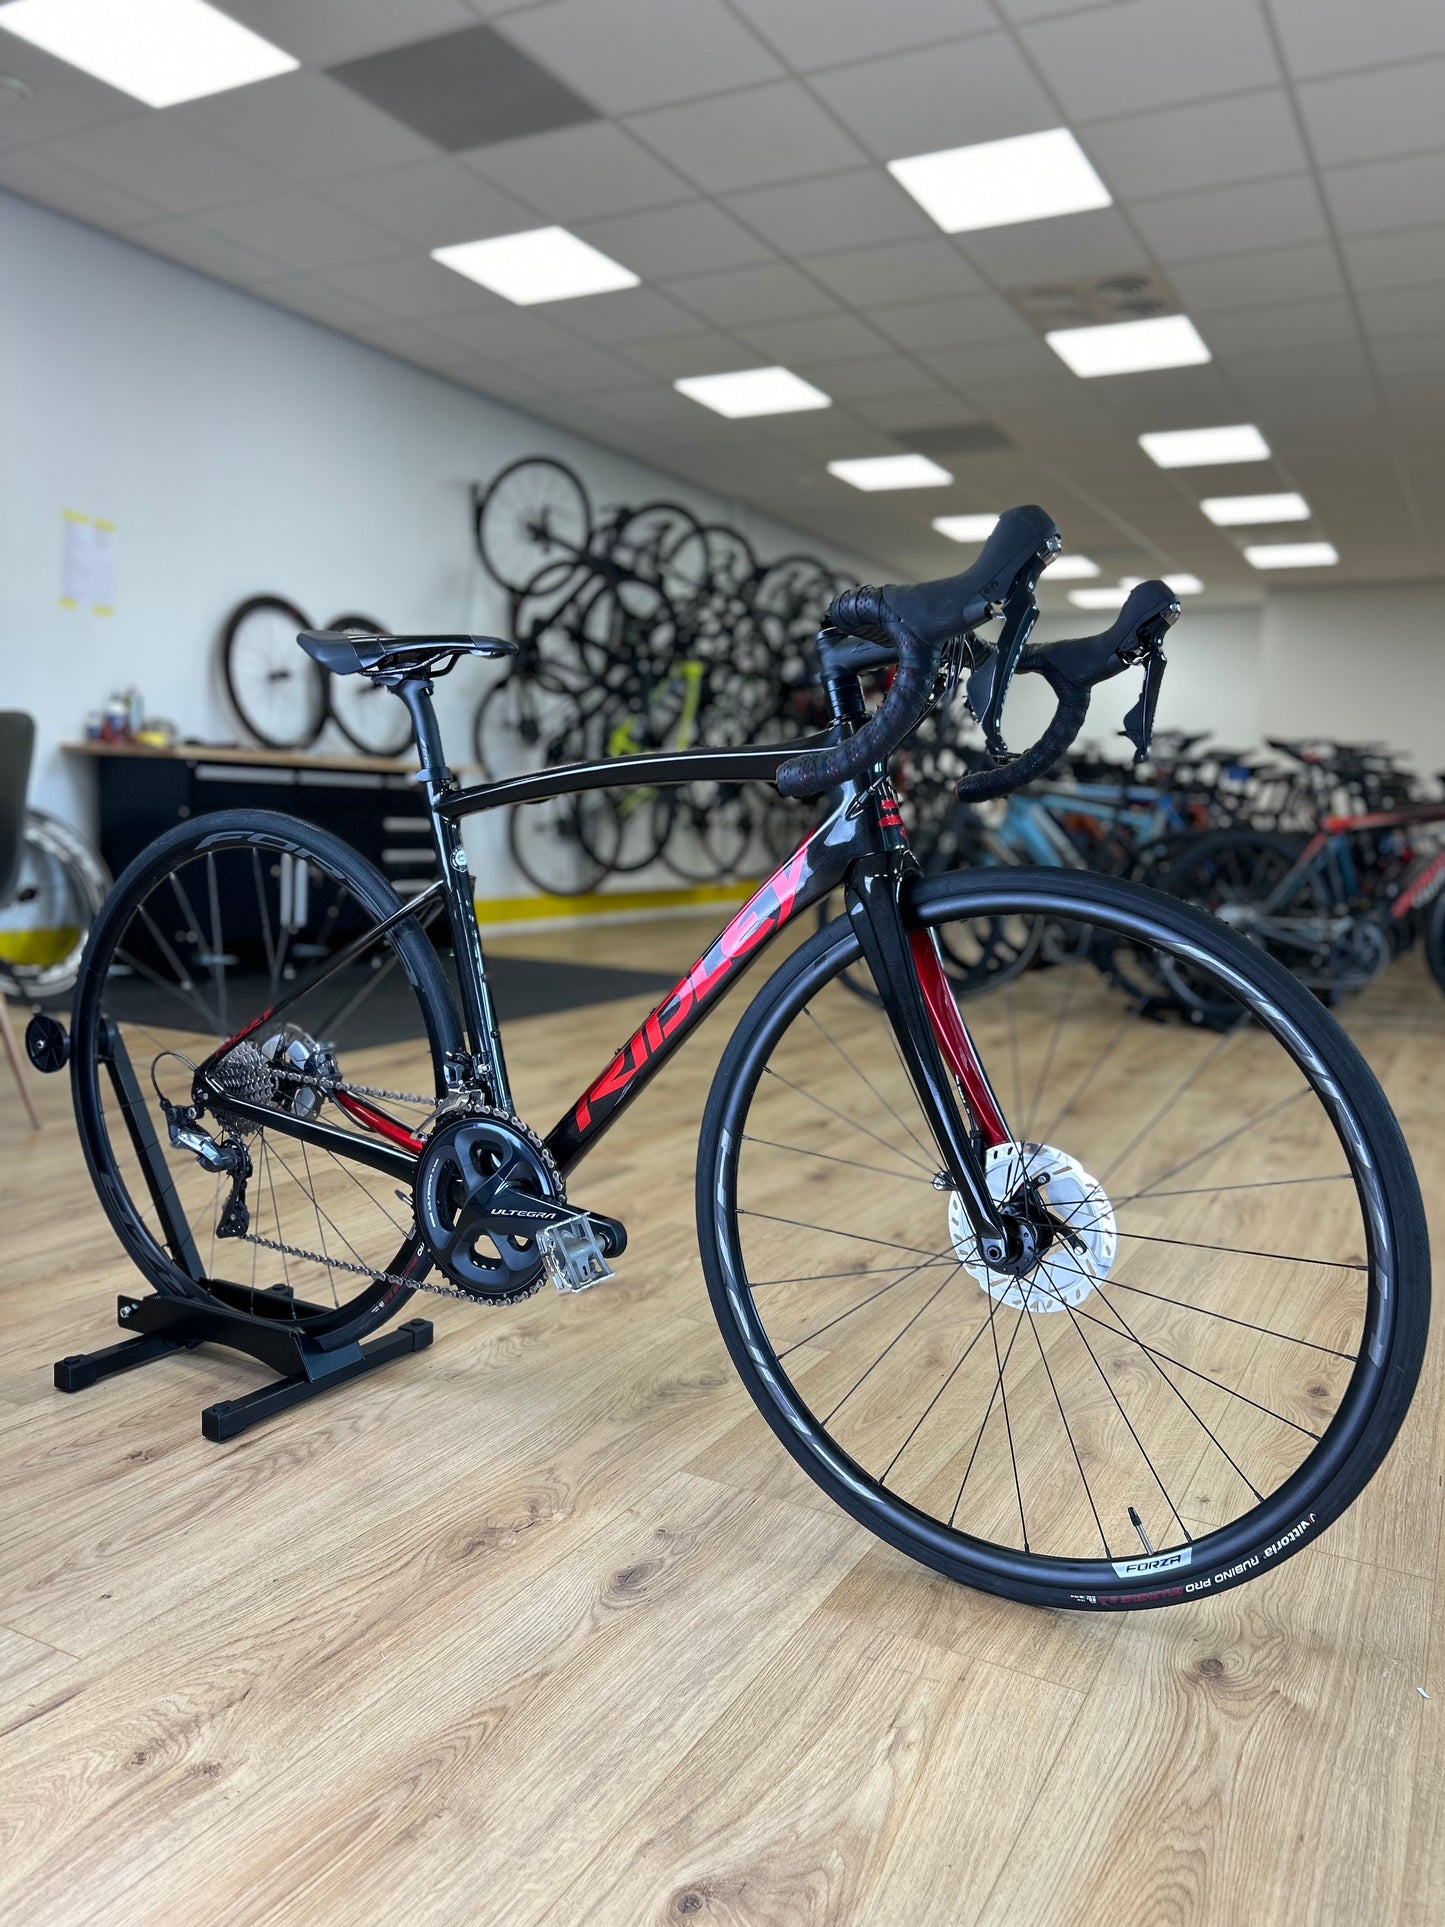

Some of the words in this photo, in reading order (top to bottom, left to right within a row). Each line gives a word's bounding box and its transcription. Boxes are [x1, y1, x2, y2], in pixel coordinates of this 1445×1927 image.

[576, 826, 815, 1132] RIDLEY
[491, 1208, 557, 1219] ULTEGRA
[1126, 1554, 1181, 1573] FORZA
[1214, 1555, 1260, 1583] RUBINO
[1185, 1578, 1212, 1592] PRO
